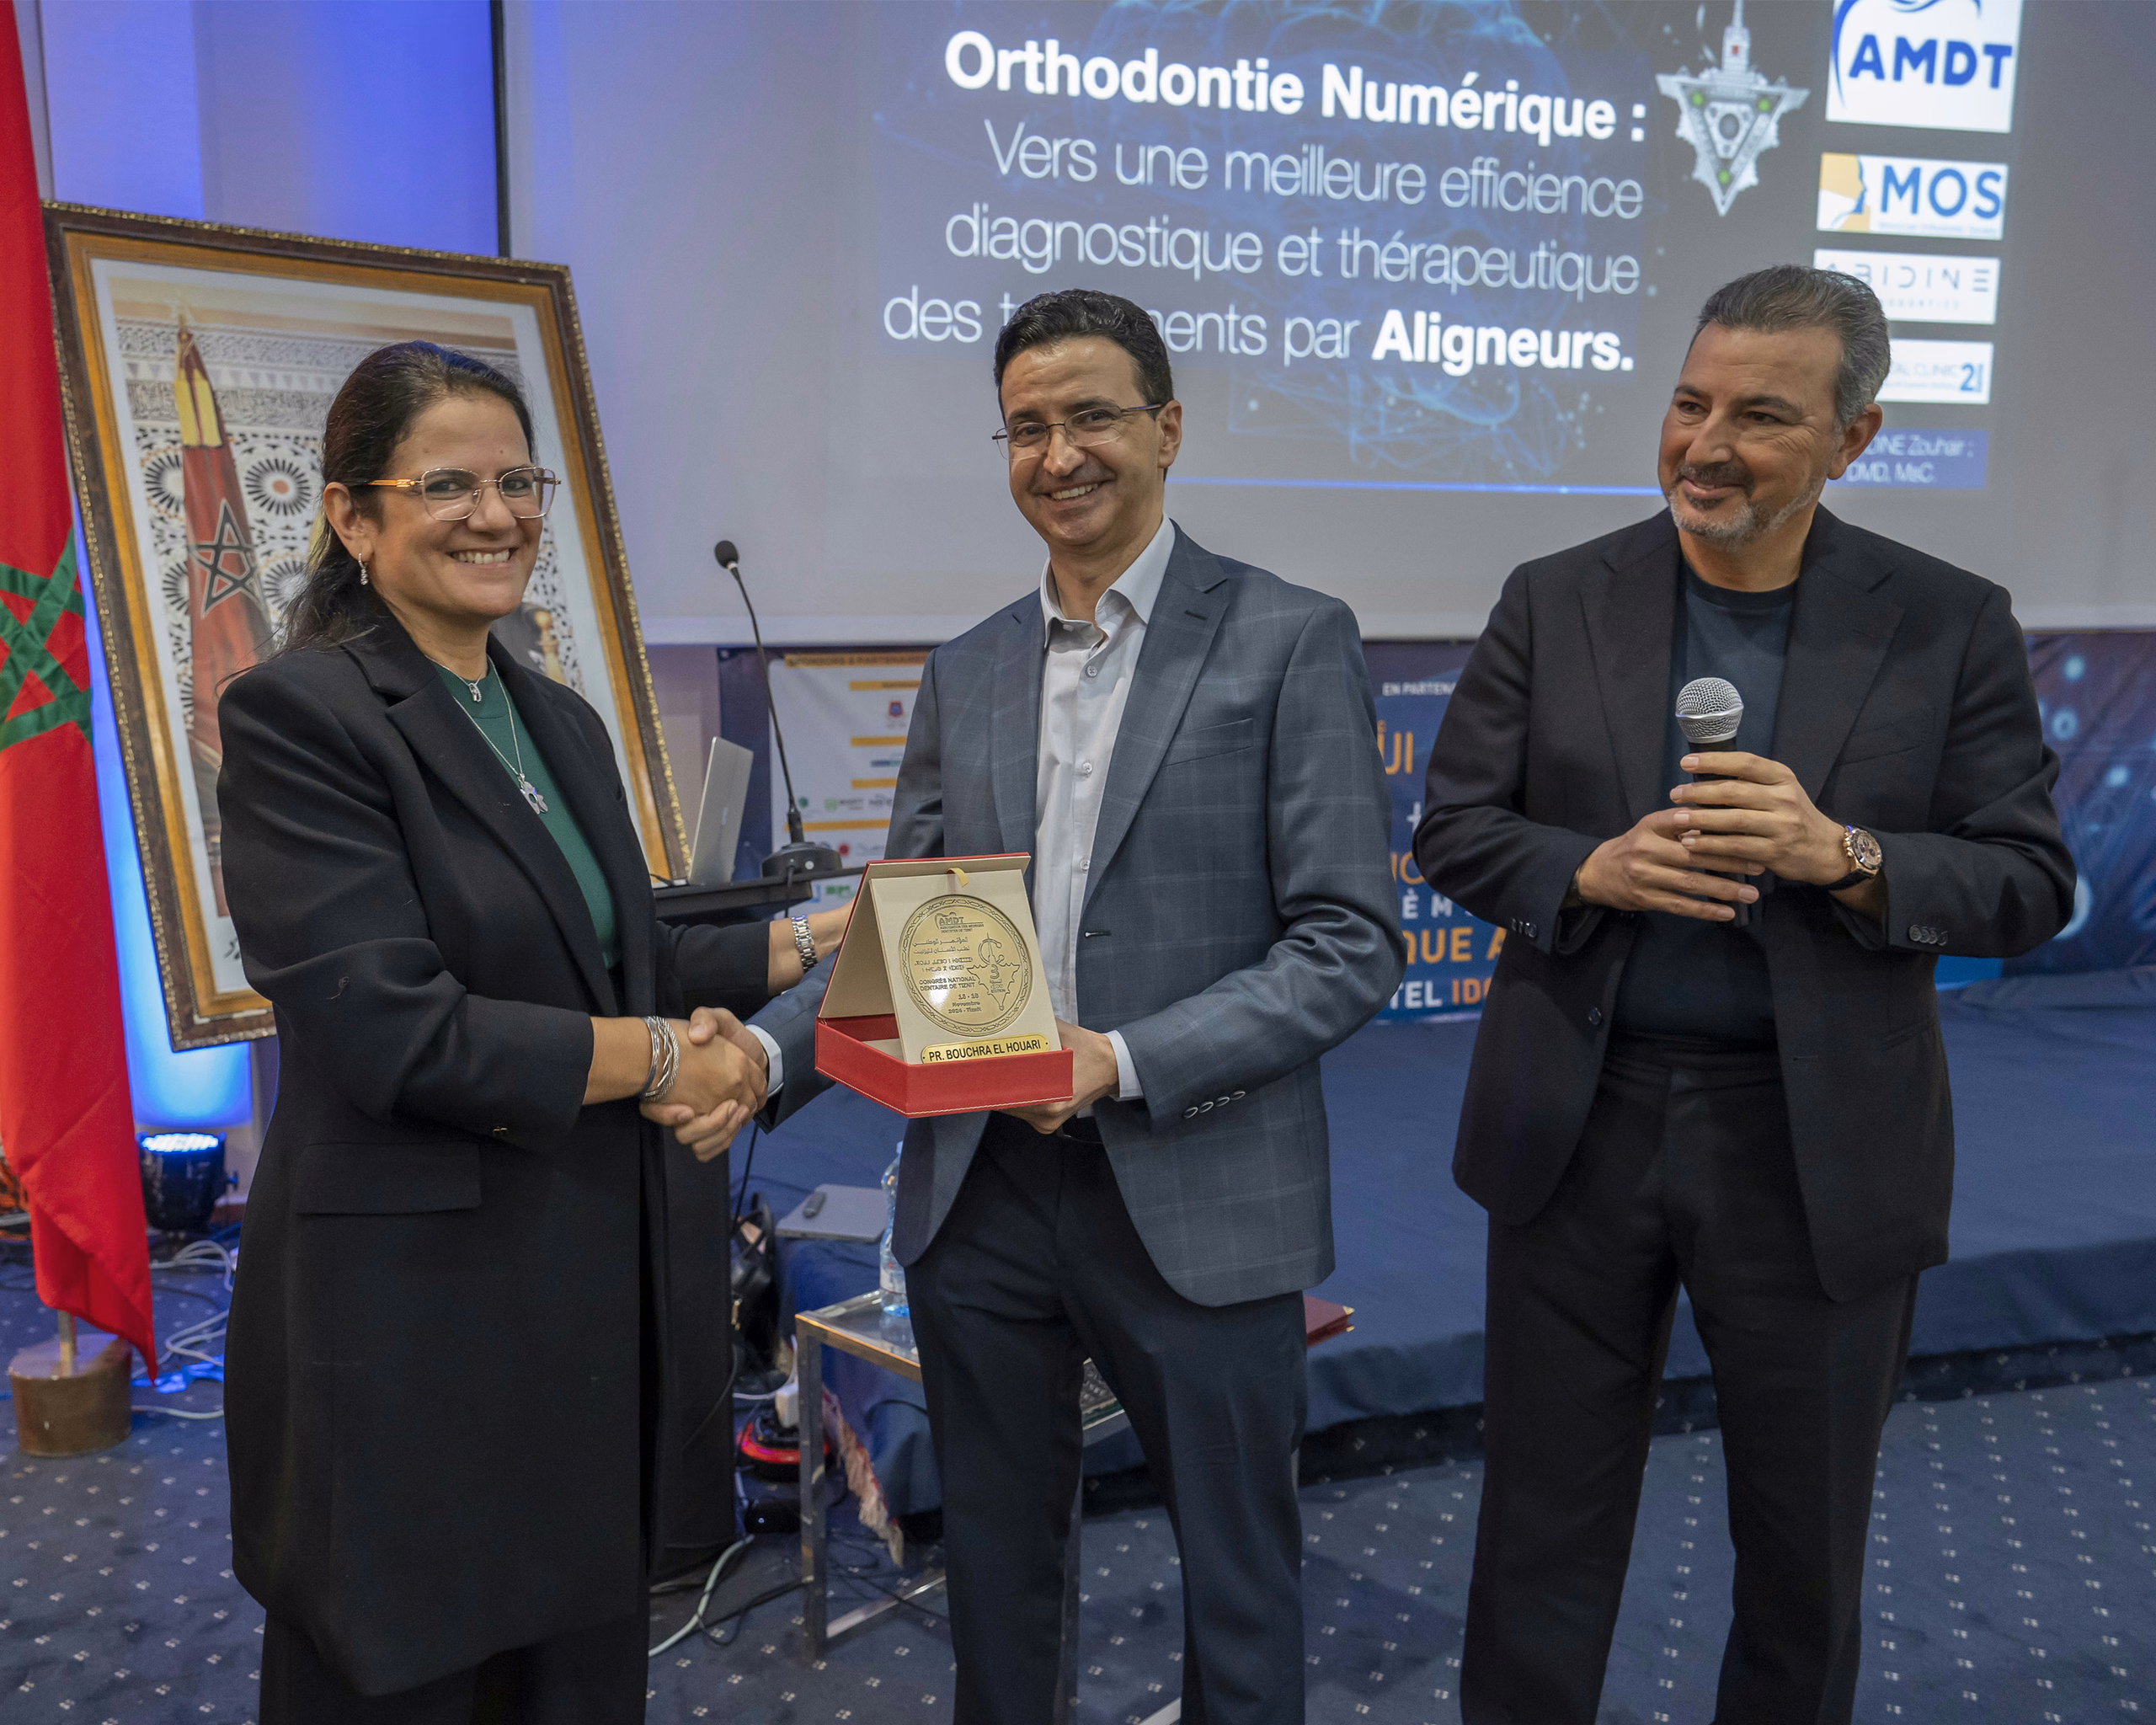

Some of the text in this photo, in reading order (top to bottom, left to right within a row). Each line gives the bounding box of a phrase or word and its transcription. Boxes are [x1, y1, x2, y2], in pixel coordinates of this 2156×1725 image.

[945, 30, 1305, 115] Orthodontie
[1321, 63, 1616, 147] Numérique
[1849, 34, 2012, 89] AMDT
[984, 119, 1643, 219] Vers une meilleure efficience
[1881, 165, 2001, 219] MOS
[946, 202, 1640, 302] diagnostique et thérapeutique
[883, 285, 982, 343] des
[1284, 317, 1361, 366] par
[1371, 309, 1634, 376] Aligneurs.
[1382, 682, 1401, 696] EN
[990, 964, 1000, 979] 3
[929, 1039, 1041, 1061] PR. BOUCHRA EL HOUARI
